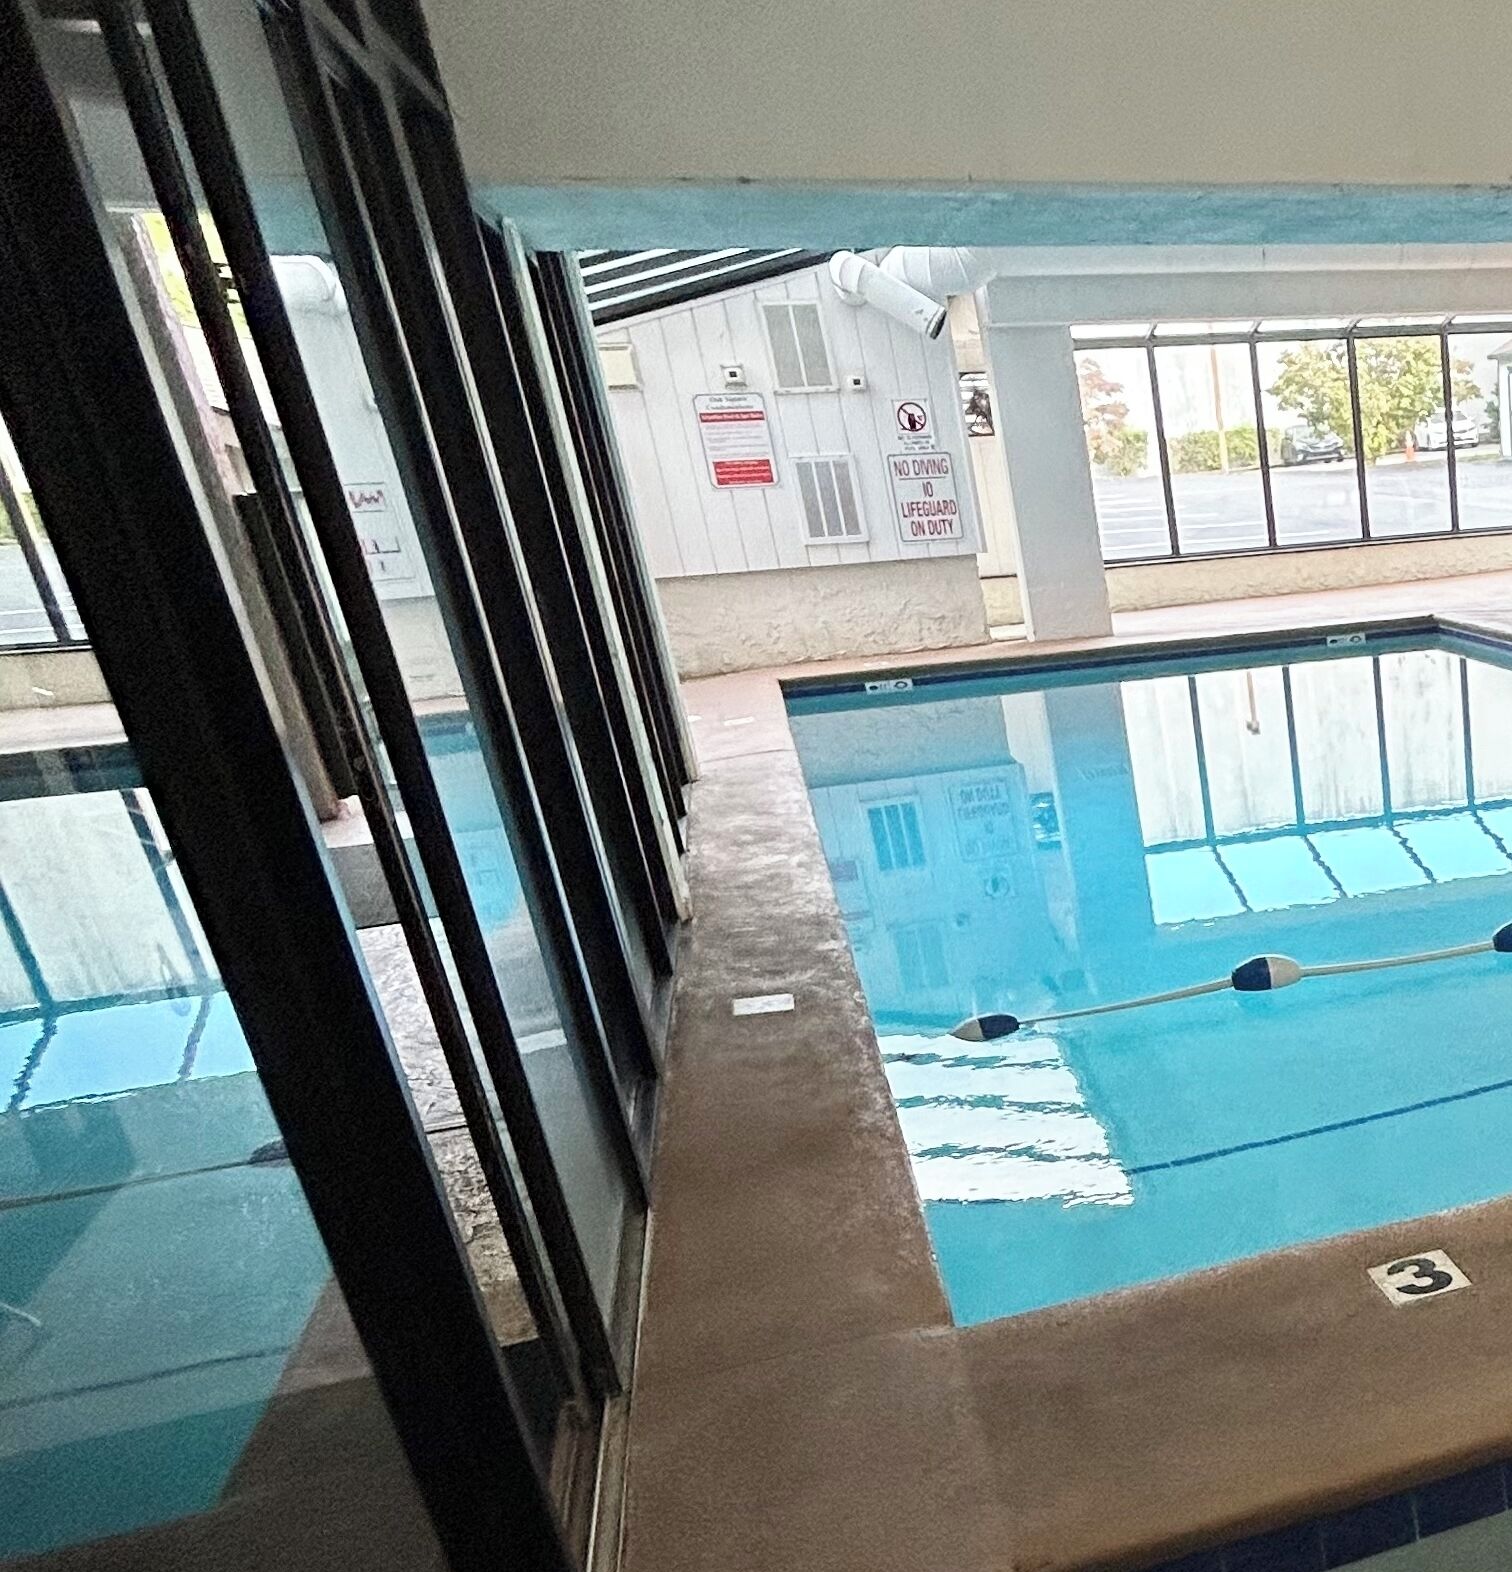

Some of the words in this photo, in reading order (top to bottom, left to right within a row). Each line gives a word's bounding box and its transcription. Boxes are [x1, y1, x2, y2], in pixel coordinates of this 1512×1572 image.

[894, 459, 910, 476] NO
[912, 458, 949, 475] DIVING
[901, 499, 957, 518] LIFEGUARD
[911, 520, 926, 537] ON
[927, 519, 953, 535] DUTY
[1387, 1258, 1453, 1295] 3
